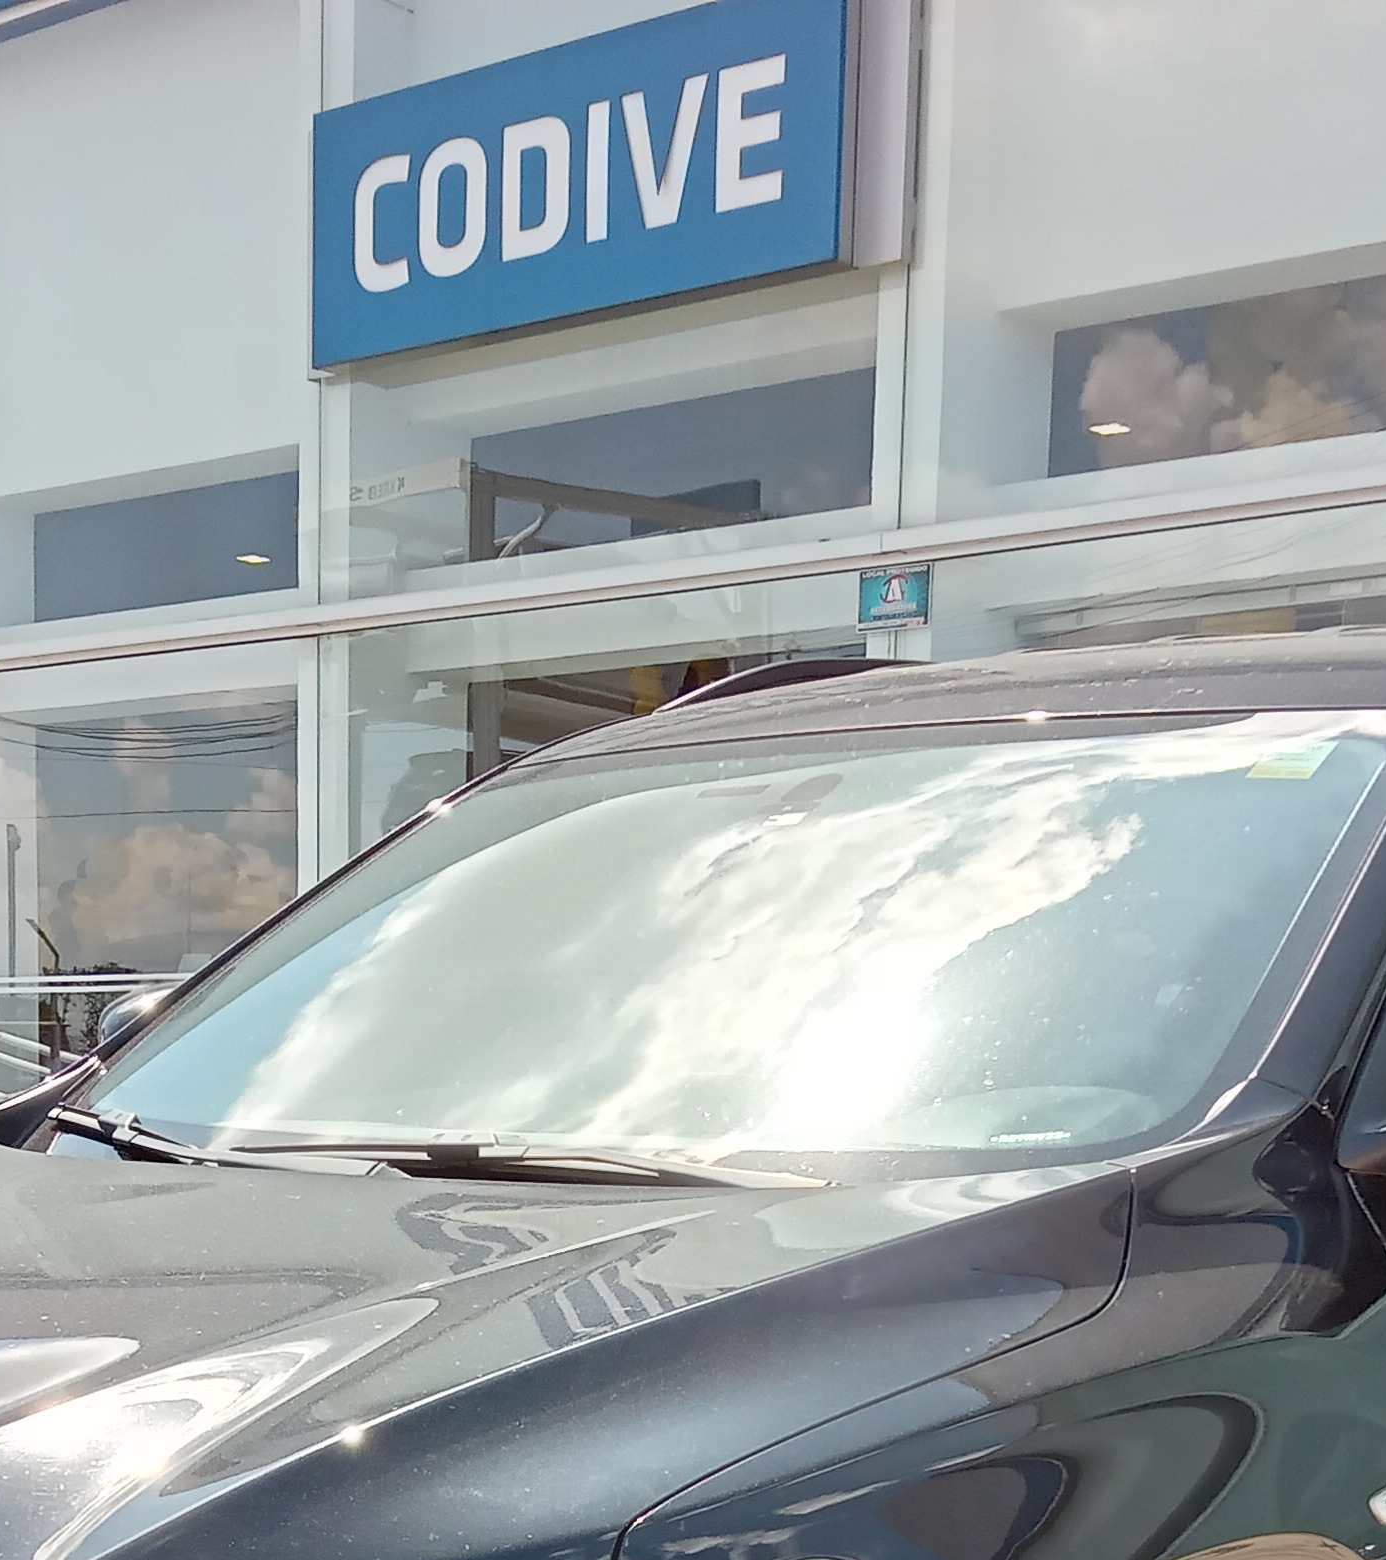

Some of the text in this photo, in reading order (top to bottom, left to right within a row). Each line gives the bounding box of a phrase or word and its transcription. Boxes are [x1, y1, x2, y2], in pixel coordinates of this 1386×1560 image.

[353, 53, 787, 293] CODIVE
[862, 565, 928, 579] LOCAL PROTEGIDO
